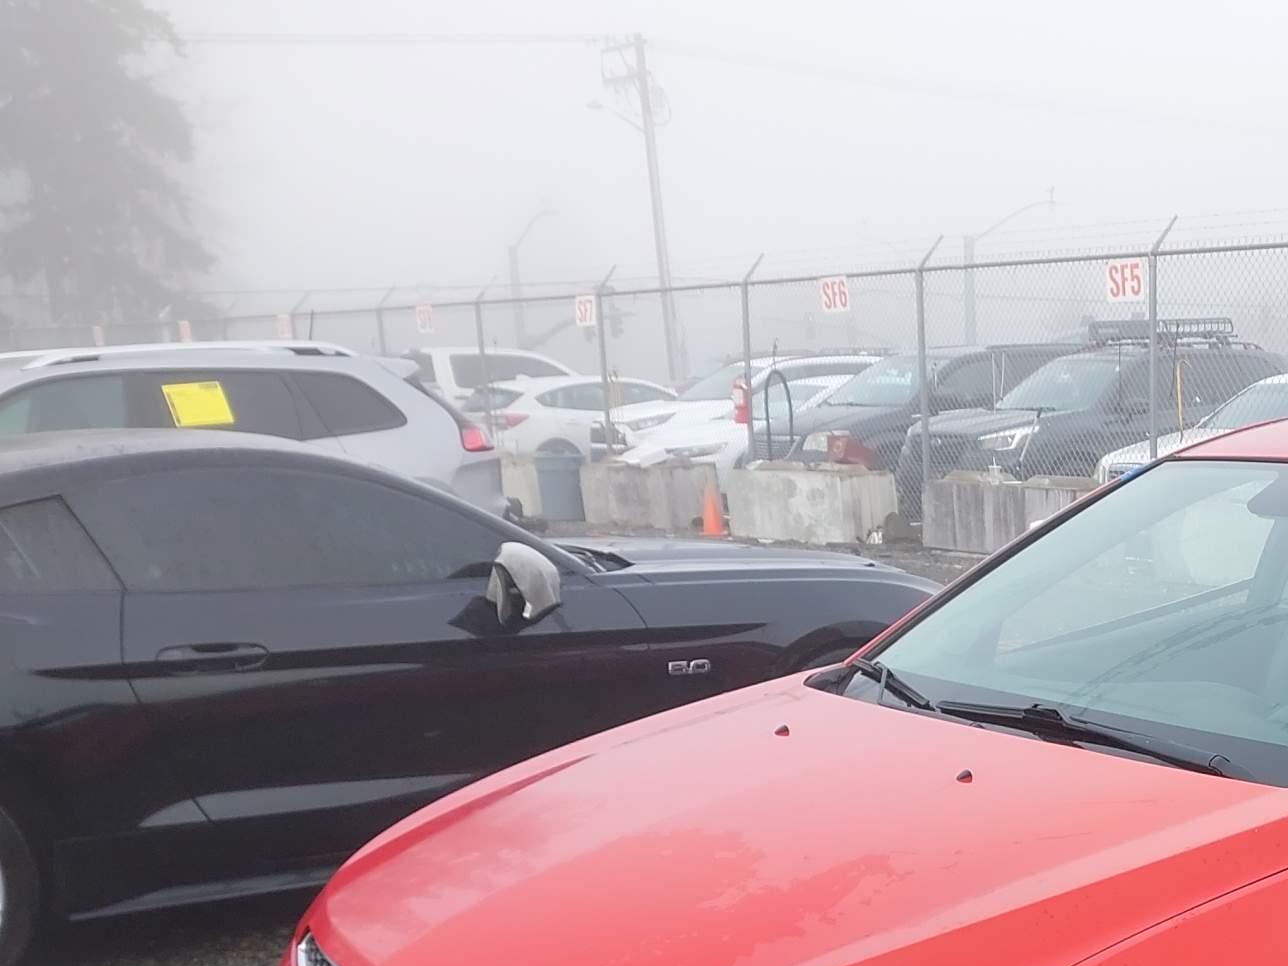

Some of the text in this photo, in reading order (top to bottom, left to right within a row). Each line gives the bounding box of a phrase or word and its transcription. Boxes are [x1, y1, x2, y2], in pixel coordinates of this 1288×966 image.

[822, 279, 848, 309] SF6
[1108, 262, 1141, 298] SF5
[577, 299, 593, 323] SF7
